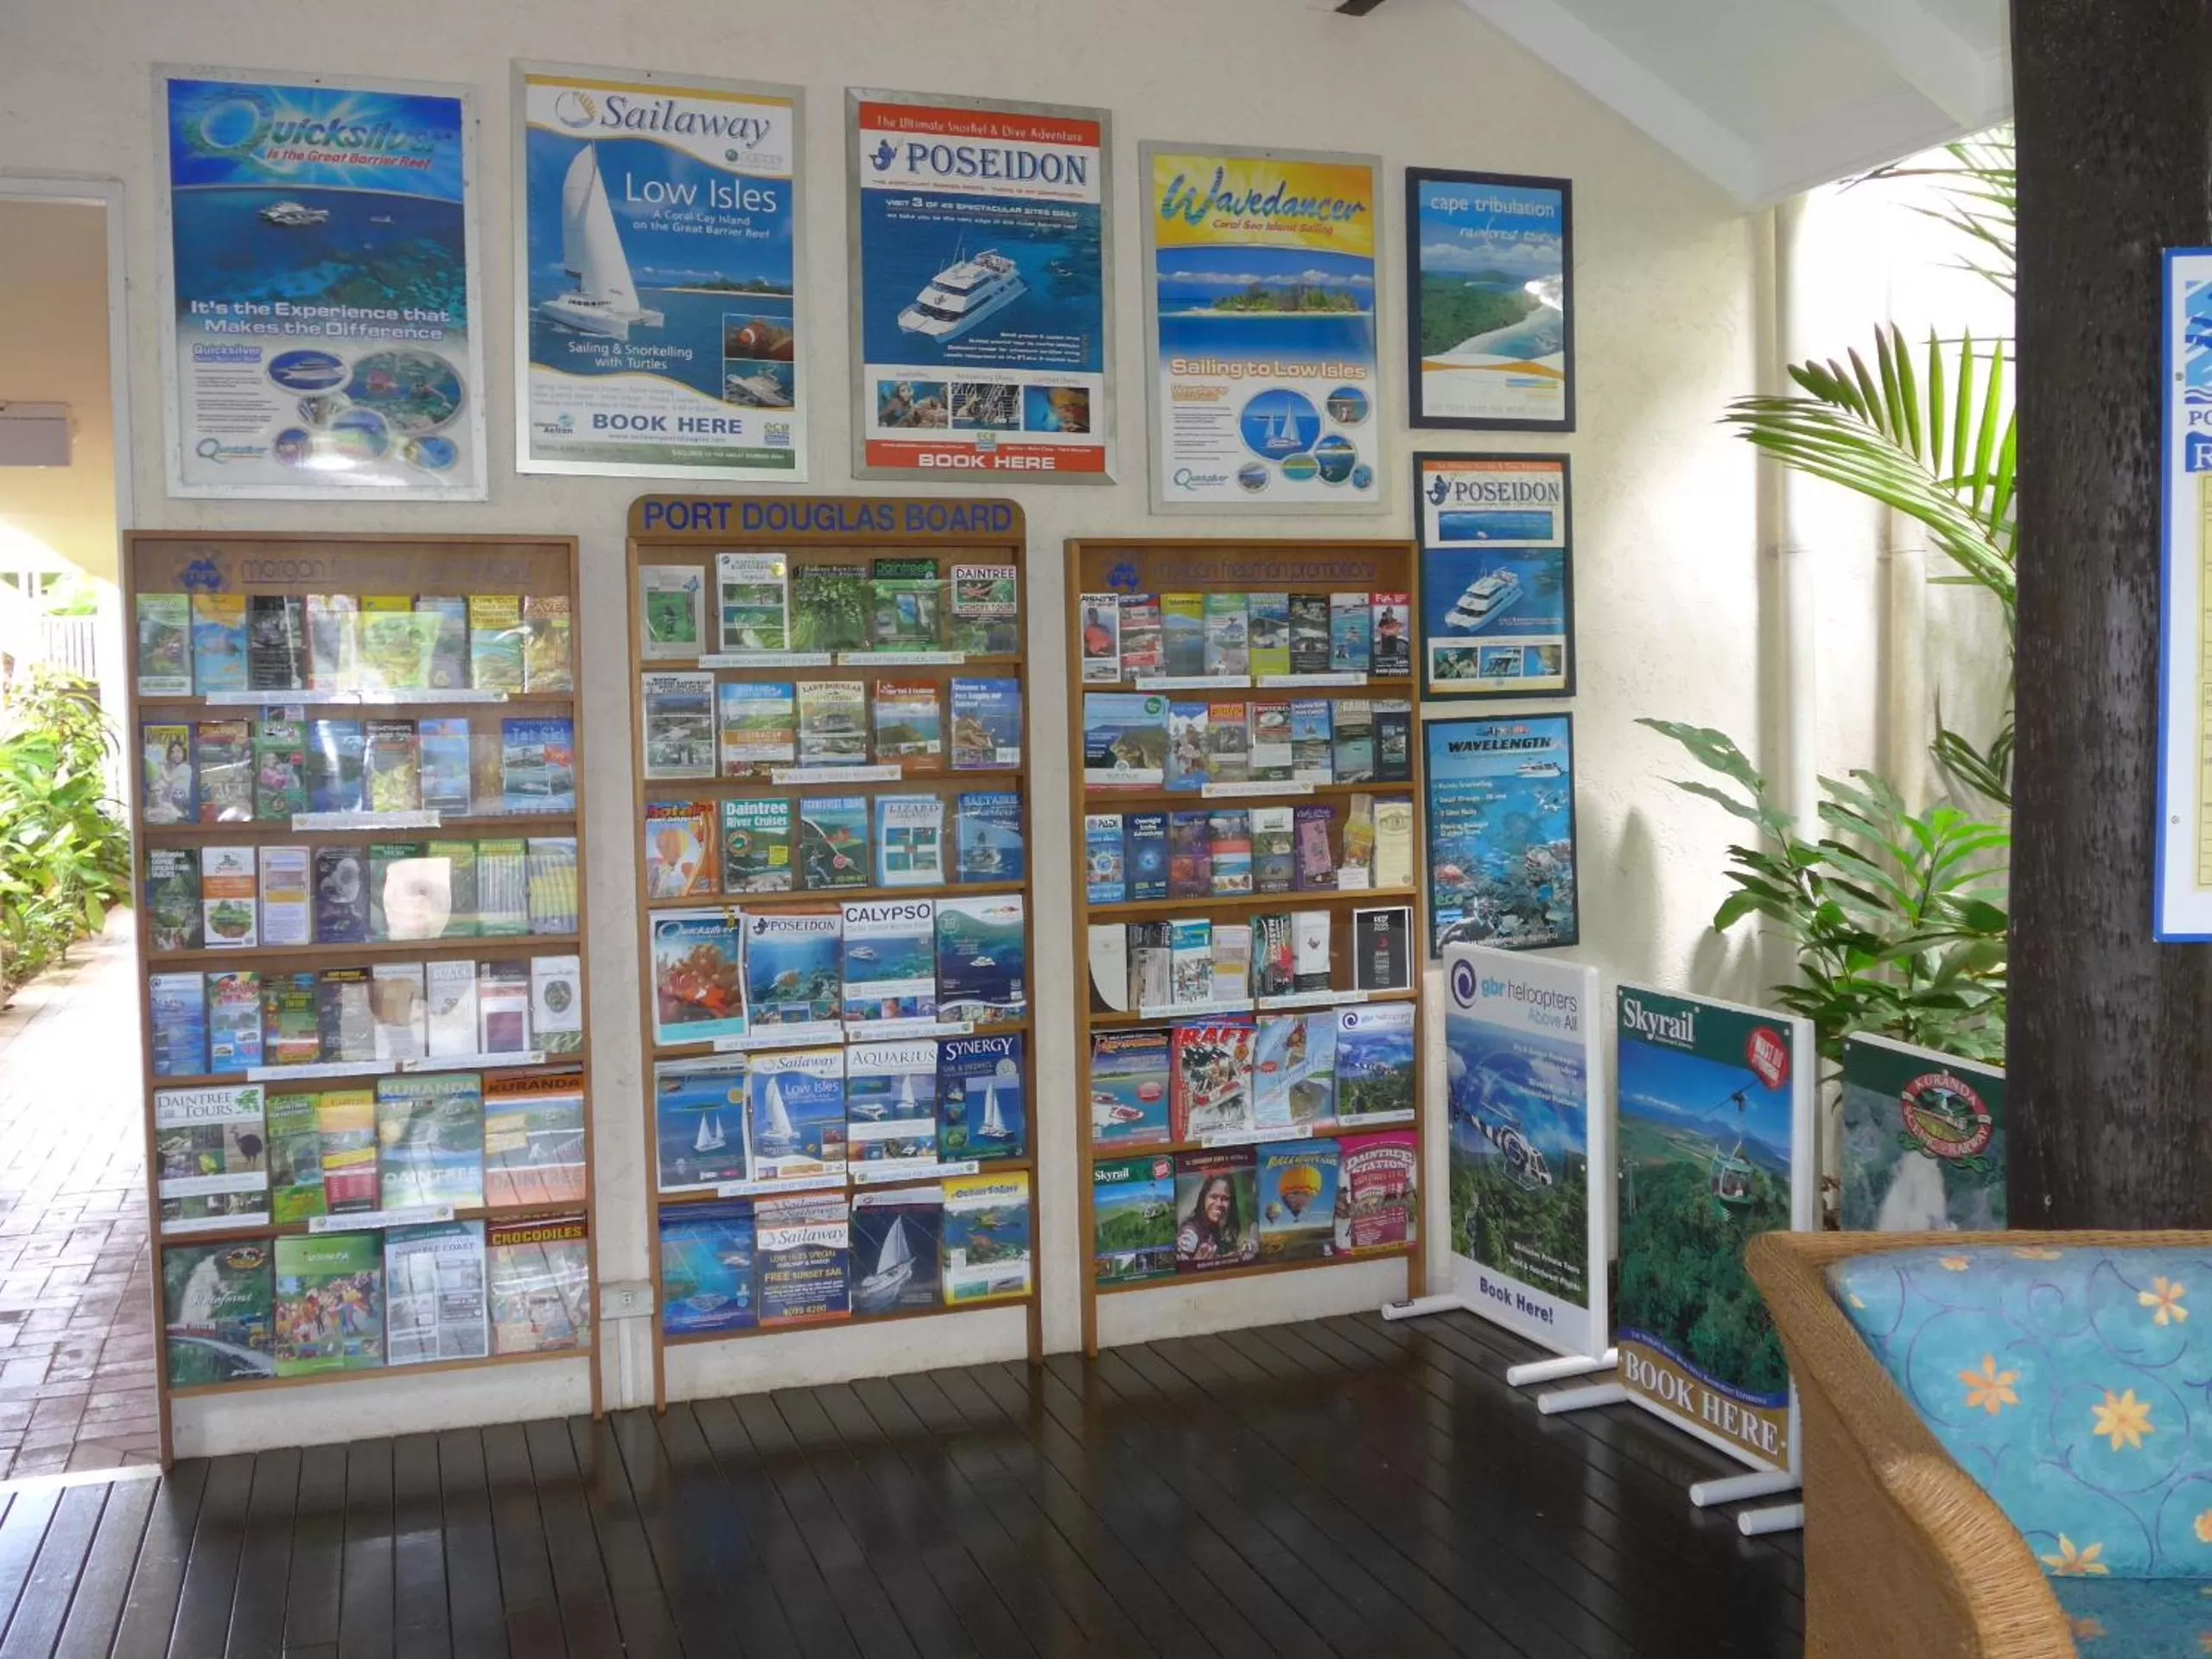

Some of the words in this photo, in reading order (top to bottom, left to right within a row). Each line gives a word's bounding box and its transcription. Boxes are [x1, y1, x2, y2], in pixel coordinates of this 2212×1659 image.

[601, 95, 772, 149] Sailaway
[877, 115, 897, 127] The
[899, 118, 944, 131] Ultimate
[1002, 124, 1026, 138] Dive
[1031, 127, 1083, 143] Adventure
[283, 149, 304, 161] the
[307, 151, 346, 163] Great
[349, 153, 397, 167] Barrier
[400, 156, 430, 169] Reef
[906, 143, 1088, 186] POSEIDON
[626, 172, 697, 206] Low
[710, 179, 777, 213] Isles
[1161, 166, 1366, 227] Wavedancer
[912, 197, 923, 207] 3
[1430, 196, 1469, 216] cape
[1475, 197, 1554, 217] tribulation
[653, 210, 661, 219] A
[664, 211, 693, 221] Coral
[719, 213, 750, 226] Island
[632, 221, 646, 230] on
[651, 221, 669, 232] the
[672, 222, 702, 234] Great
[706, 225, 742, 237] Barrier
[746, 226, 770, 238] Reef
[1212, 219, 1240, 230] Coral
[1300, 223, 1333, 236] Sailing
[190, 300, 228, 315] It's
[233, 302, 270, 316] the
[275, 302, 400, 321] Experience
[404, 308, 450, 322] that
[205, 319, 278, 334] Makes
[284, 321, 320, 335] the
[326, 322, 442, 340] Difference
[569, 341, 608, 356] Sailing
[613, 343, 622, 354] &
[625, 344, 692, 359] Snorkelling
[594, 357, 622, 367] with
[627, 358, 667, 371] Turtles
[1172, 359, 1243, 379] Sailing
[1248, 360, 1270, 377] to
[1274, 361, 1317, 378] Low
[1321, 362, 1366, 378] Isles
[592, 413, 667, 432] BOOK
[677, 416, 742, 435] HERE
[918, 454, 986, 468] BOOK
[994, 456, 1055, 470] HERE
[1455, 480, 1560, 502] POSEIDON
[645, 501, 732, 531] PORT
[741, 503, 896, 533] DOUGLAS
[905, 505, 1013, 533] BOARD
[239, 558, 324, 580] morgan
[957, 569, 1014, 579] DAINTREE
[1448, 737, 1552, 753] WAVELENGTH
[727, 801, 788, 816] Daintree
[888, 804, 940, 813] LIZARD
[727, 817, 751, 828] River
[754, 817, 788, 827] Cruises
[846, 904, 931, 923] CALYPSO
[769, 919, 836, 932] POSEIDON
[1481, 976, 1506, 997] gbr
[1508, 979, 1578, 1012] helicopters
[1529, 1007, 1562, 1028] Above
[1565, 1014, 1578, 1032] All
[1624, 998, 1694, 1043] Skyrail
[1178, 1026, 1255, 1048] RAFT
[853, 1051, 936, 1066] AQUARIUS
[946, 1038, 1013, 1061] SYNERGY
[778, 1056, 836, 1071] Sailaway
[380, 1082, 474, 1096] KURANDA
[487, 1077, 581, 1093] KURANDA
[785, 1084, 810, 1094] Low
[1915, 1076, 1976, 1106] KURANDA
[157, 1091, 232, 1108] DAINTREE
[186, 1105, 233, 1118] TOURS
[1904, 1107, 1936, 1149] SCENIC
[1346, 1148, 1414, 1170] DAINTREE
[383, 1168, 481, 1185] DAINTREE
[1095, 1167, 1129, 1182] Skyrail
[493, 1227, 582, 1245] CROCODILES
[778, 1227, 845, 1243] Sailaway
[765, 1271, 790, 1282] FREE
[825, 1268, 843, 1278] SAIL
[1479, 1275, 1512, 1306] Book
[1516, 1293, 1554, 1325] Here!
[1625, 1350, 1694, 1414] BOOK
[1701, 1389, 1778, 1456] HERE
